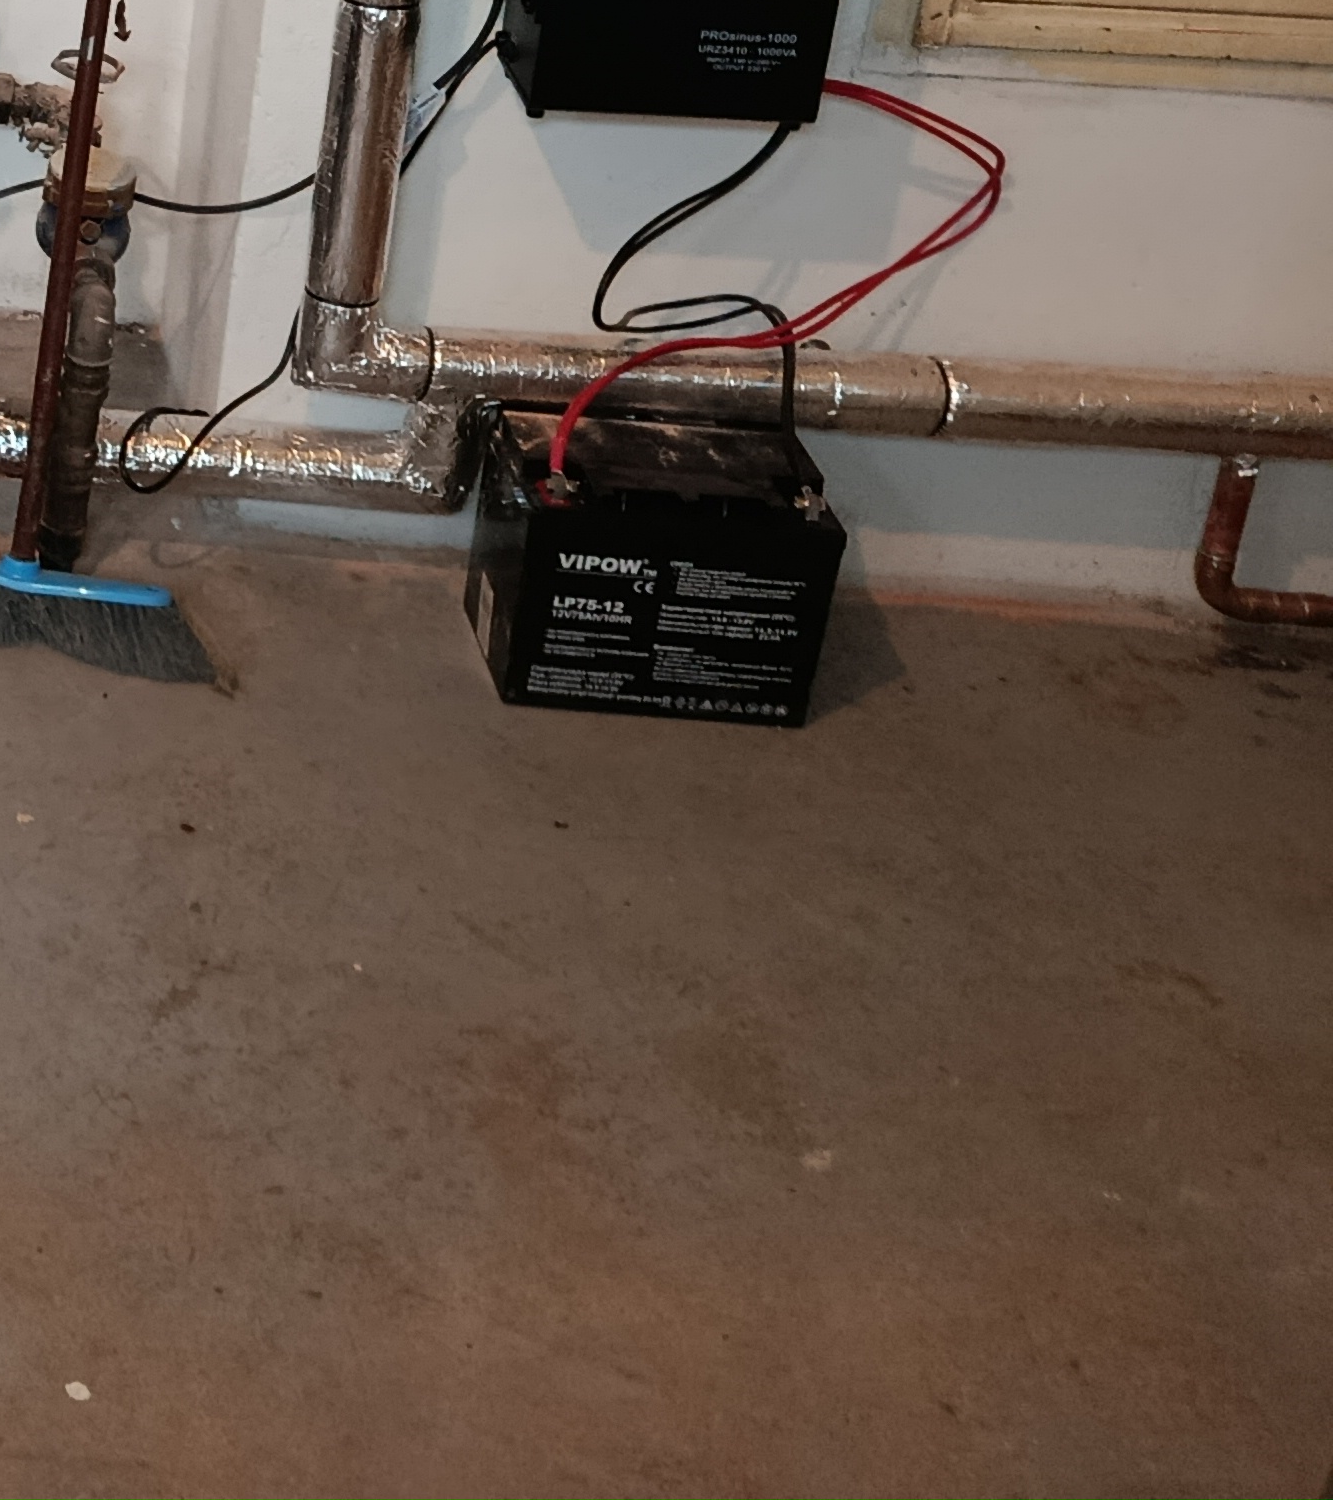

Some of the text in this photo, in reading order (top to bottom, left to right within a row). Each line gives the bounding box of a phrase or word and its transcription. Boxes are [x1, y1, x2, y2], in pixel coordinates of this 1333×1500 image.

[700, 30, 797, 44] PROsinus-1000
[698, 45, 797, 57] URZ3410 1000VA
[559, 553, 642, 575] VIPOW
[553, 595, 624, 613] LP75-12
